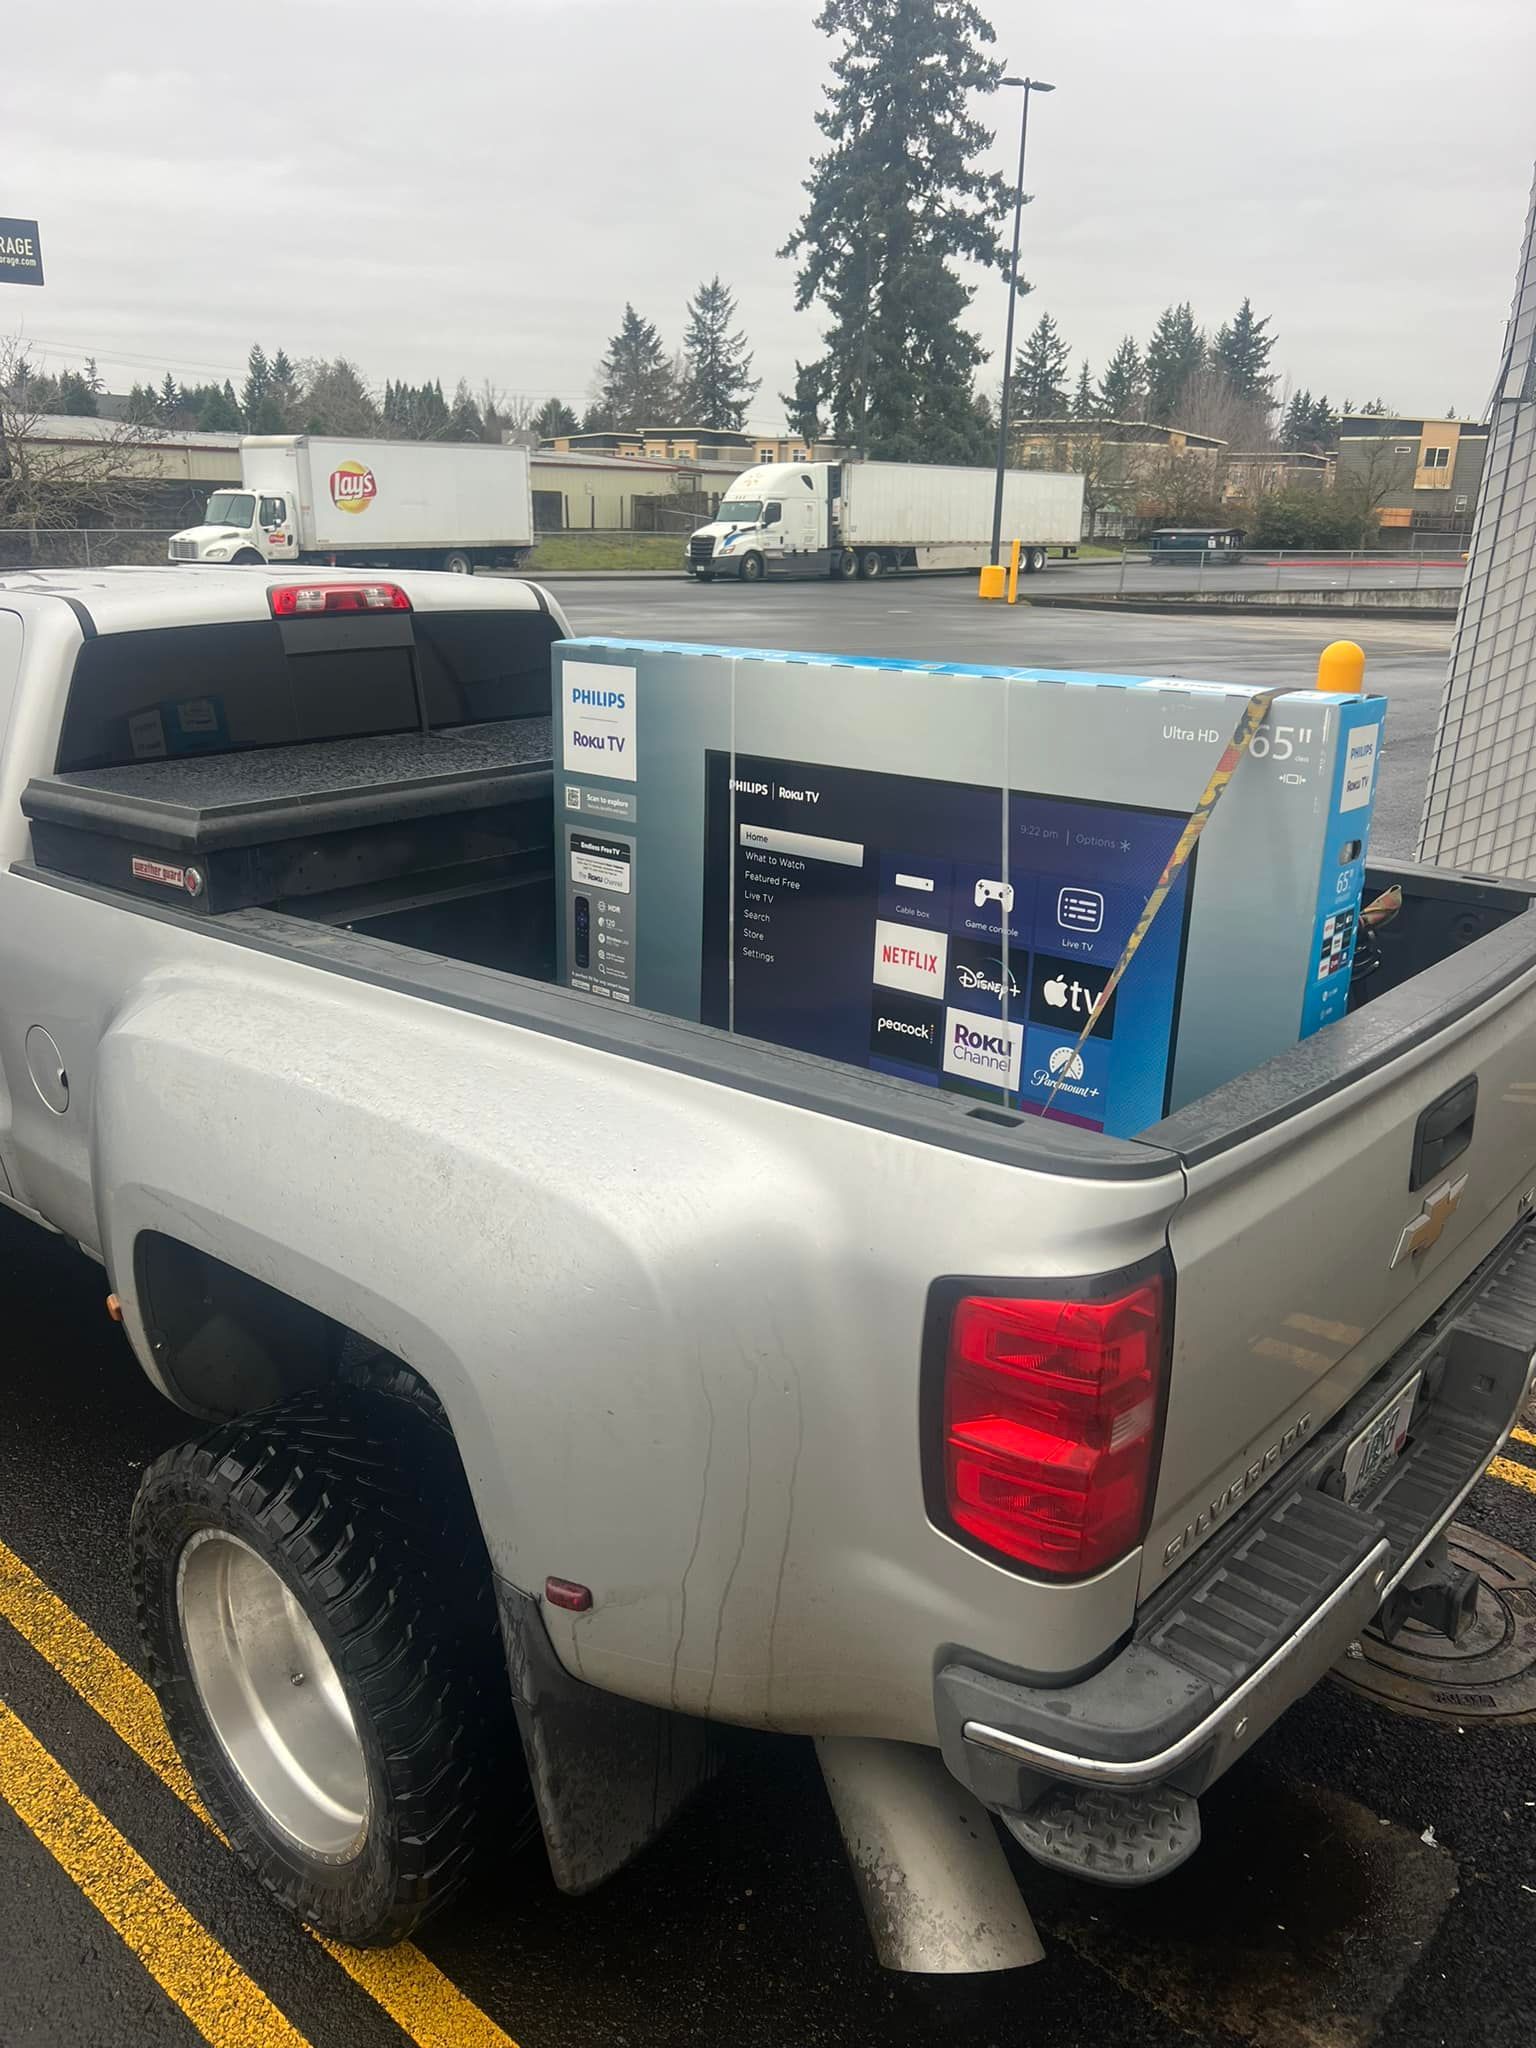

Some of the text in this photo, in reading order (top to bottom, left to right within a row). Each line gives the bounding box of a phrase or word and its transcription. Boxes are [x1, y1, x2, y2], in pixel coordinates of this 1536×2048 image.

[0, 236, 34, 256] RAGE
[334, 472, 373, 500] Lay's
[573, 688, 625, 709] PHILIPS
[1162, 725, 1220, 743] Ultra HD
[607, 735, 626, 752] TV
[729, 779, 819, 803] PHILIPS Roku TV
[586, 794, 629, 808] Scan to explore
[745, 831, 769, 844] Home
[1020, 824, 1059, 841] 9:22 pm
[580, 842, 600, 852] Endless
[1075, 833, 1116, 850] Options
[745, 852, 805, 871] What to Watch
[162, 866, 182, 882] guard
[744, 870, 801, 890] Featured Free
[744, 890, 774, 904] Live TV
[743, 909, 770, 922] Search
[895, 905, 930, 919] Cable box
[965, 919, 988, 931] Game
[743, 928, 764, 941] Store
[1062, 939, 1094, 952] Live TV
[743, 947, 775, 963] Settings
[882, 945, 938, 974] NETFLIX
[1070, 981, 1103, 1015] tv
[877, 1017, 929, 1040] peacock
[952, 1044, 1011, 1073] Channel
[1163, 1411, 1312, 1567] SILVERADO
